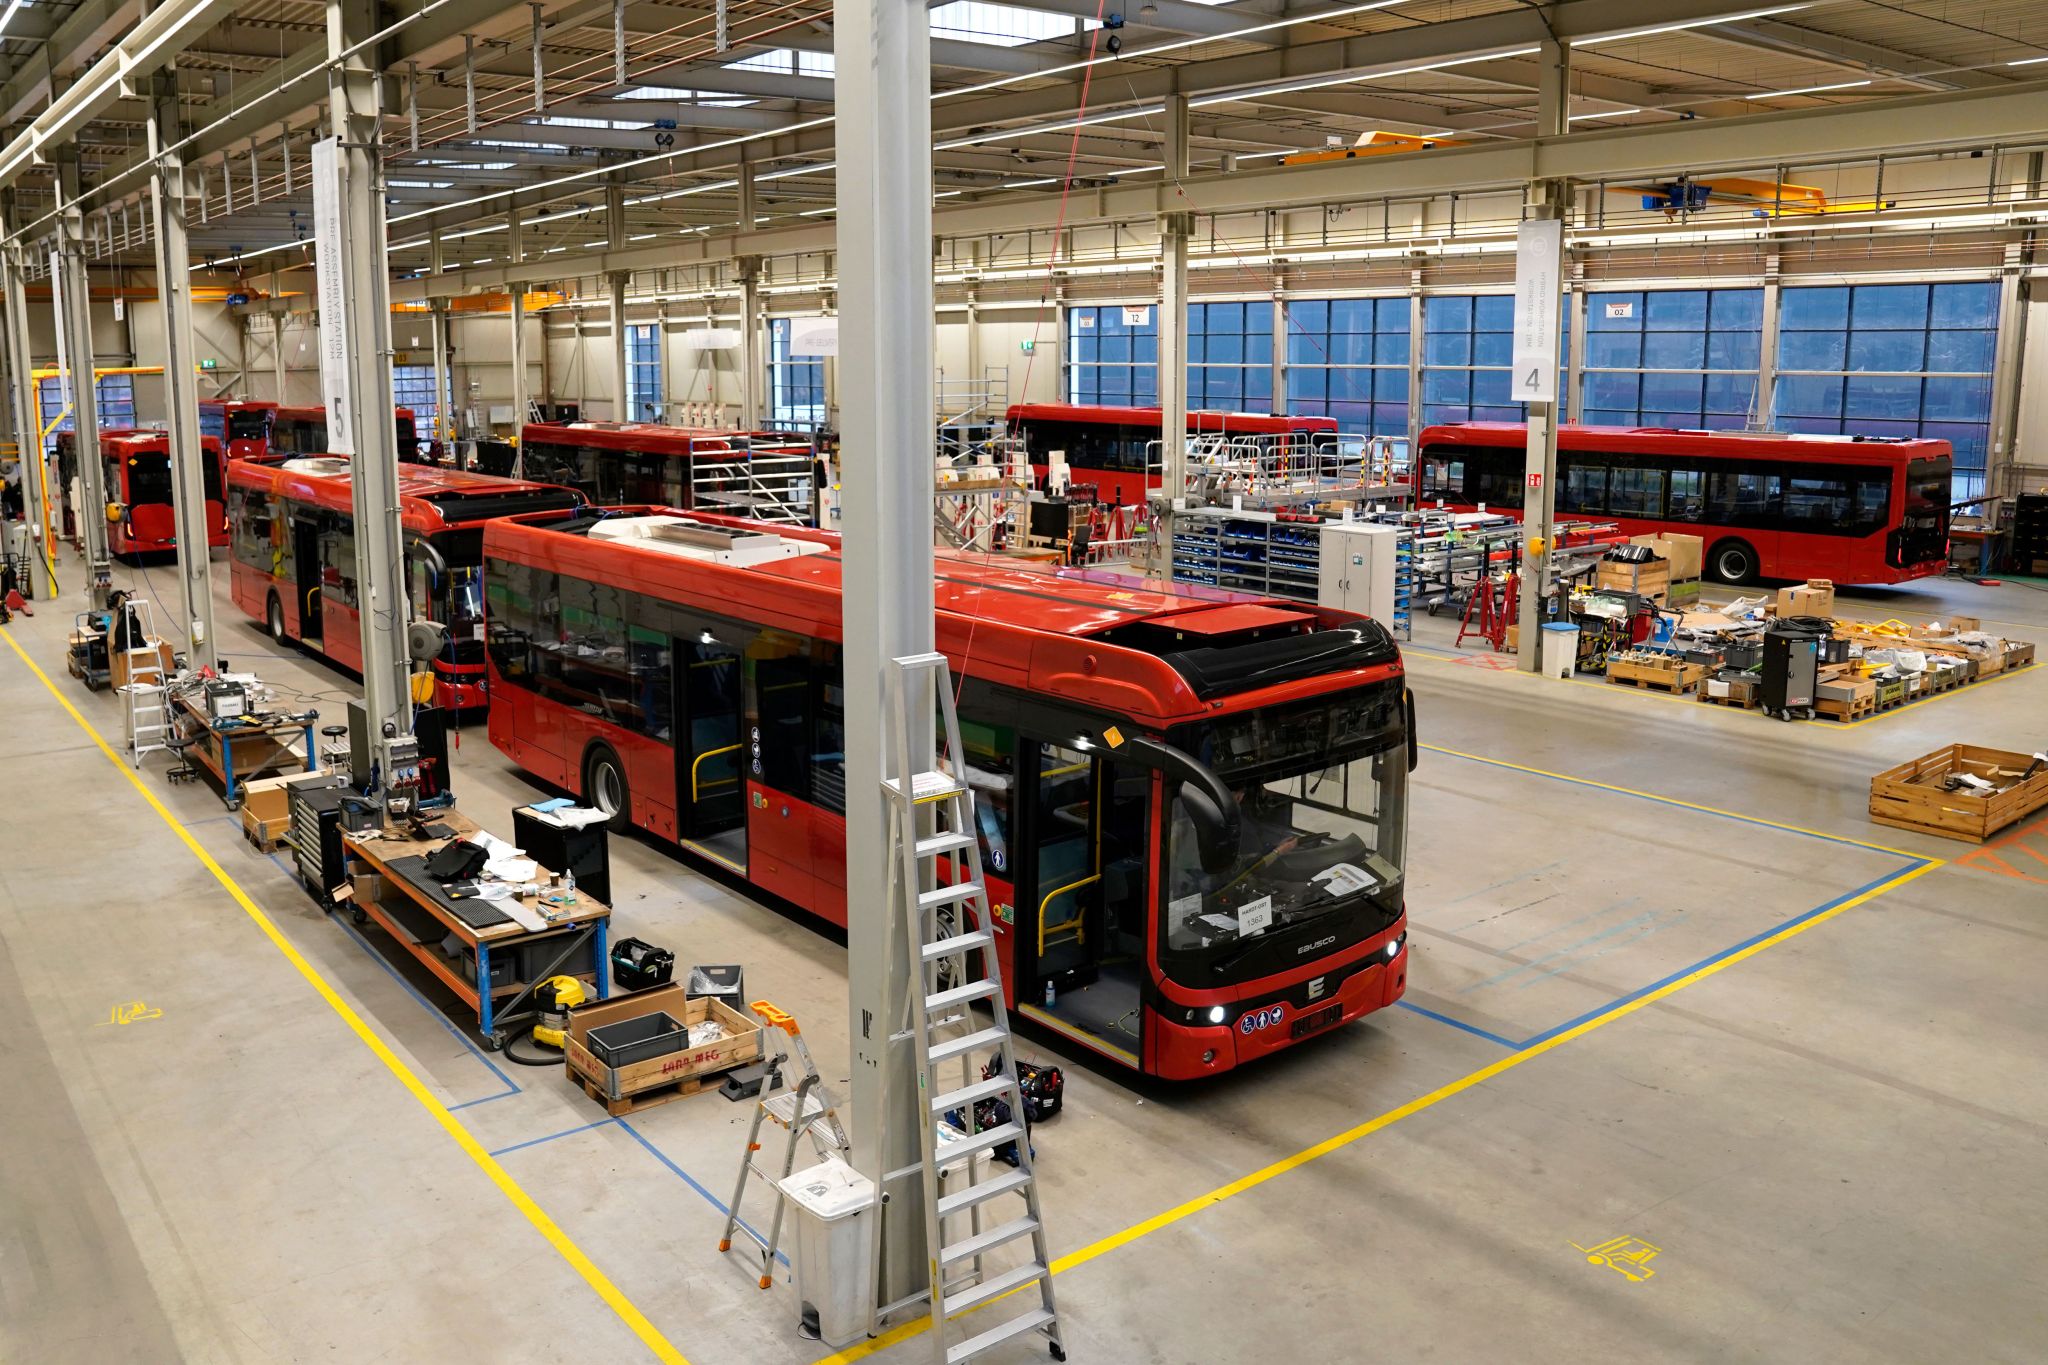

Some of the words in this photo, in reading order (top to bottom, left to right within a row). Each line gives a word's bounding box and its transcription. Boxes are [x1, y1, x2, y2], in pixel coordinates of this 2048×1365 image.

[1131, 314, 1140, 323] 12
[334, 311, 343, 360] STATION
[1525, 368, 1540, 393] 4
[334, 397, 344, 439] 5
[1247, 914, 1264, 927] 1363
[1297, 935, 1336, 955] EBUSCO
